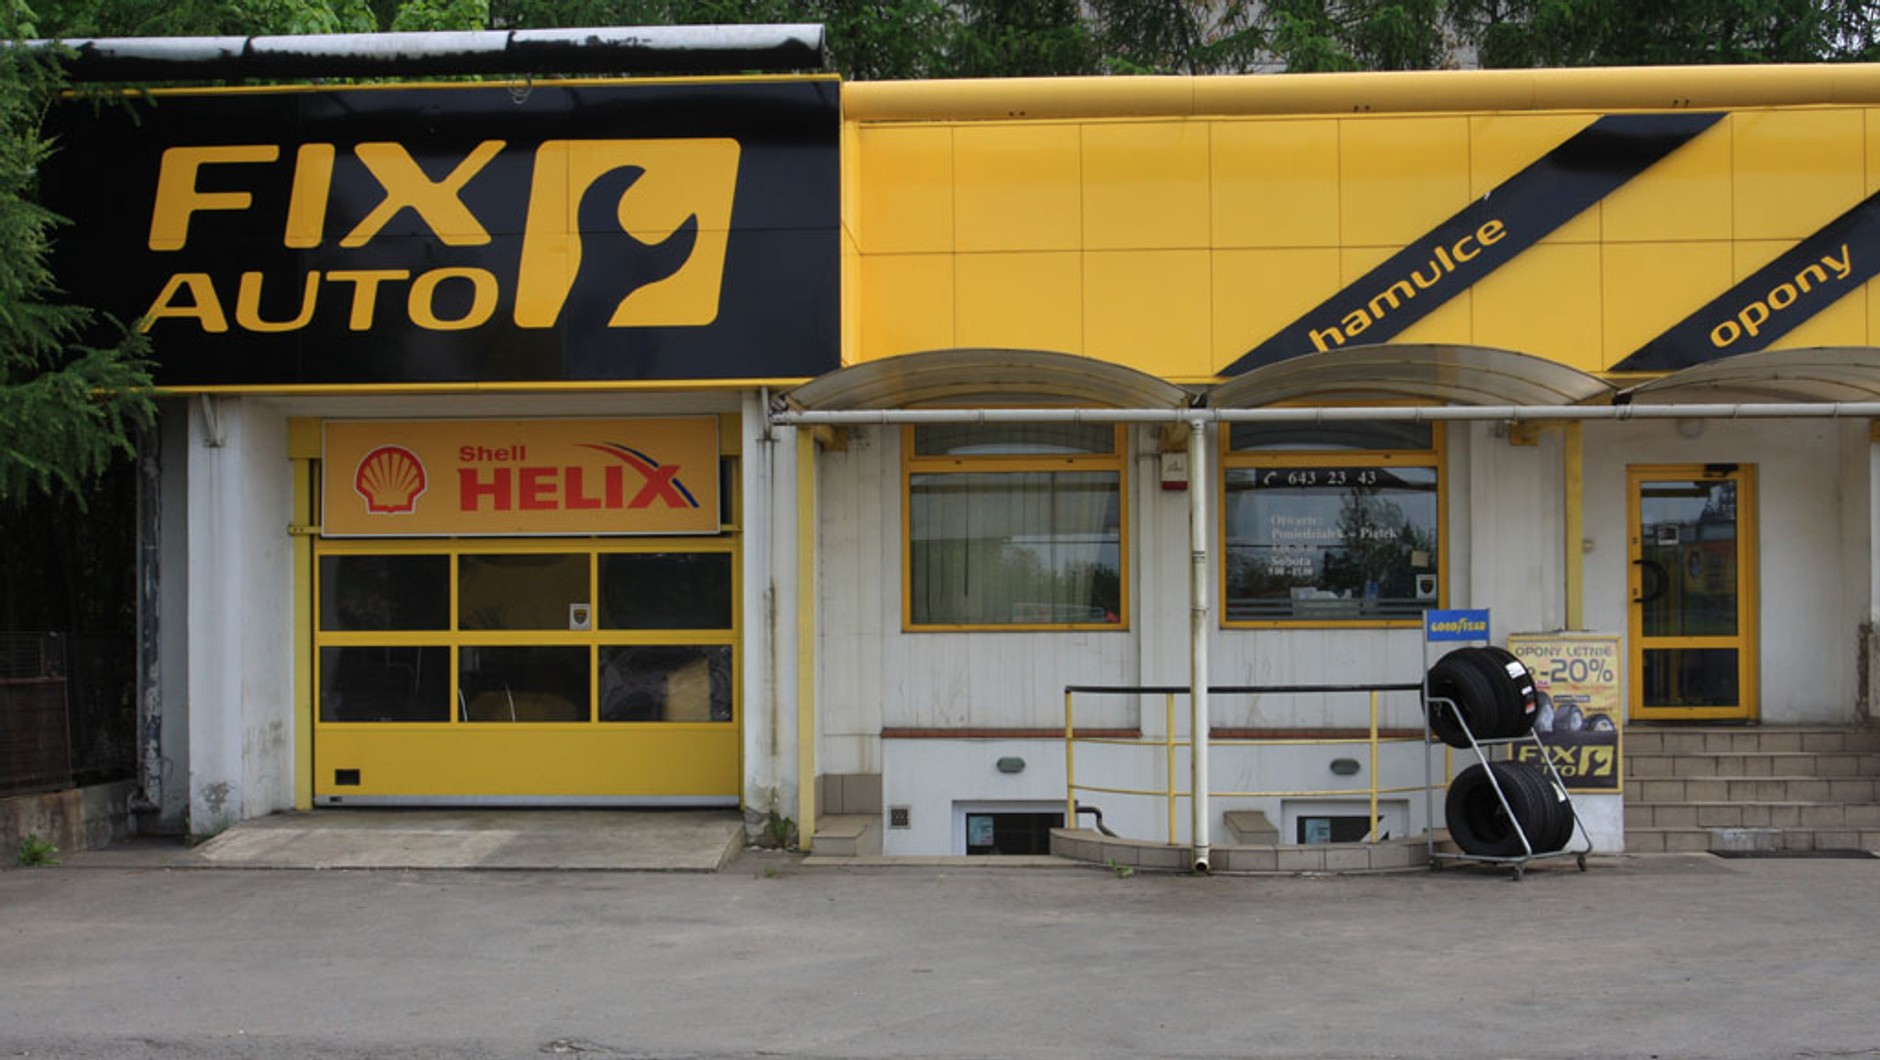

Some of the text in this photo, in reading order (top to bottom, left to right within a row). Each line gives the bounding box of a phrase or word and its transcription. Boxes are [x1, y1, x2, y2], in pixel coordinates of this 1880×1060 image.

[149, 140, 507, 250] FIX
[140, 267, 499, 333] AUTO
[1308, 219, 1507, 352] hamulce
[1710, 243, 1851, 348] opony
[459, 445, 526, 461] Shell
[457, 464, 690, 511] HELIX
[1288, 471, 1377, 485] 643 23 43
[1431, 617, 1487, 634] GOODYEAR
[1515, 646, 1612, 657] OPONY LETNIE
[1518, 744, 1578, 764] FIX
